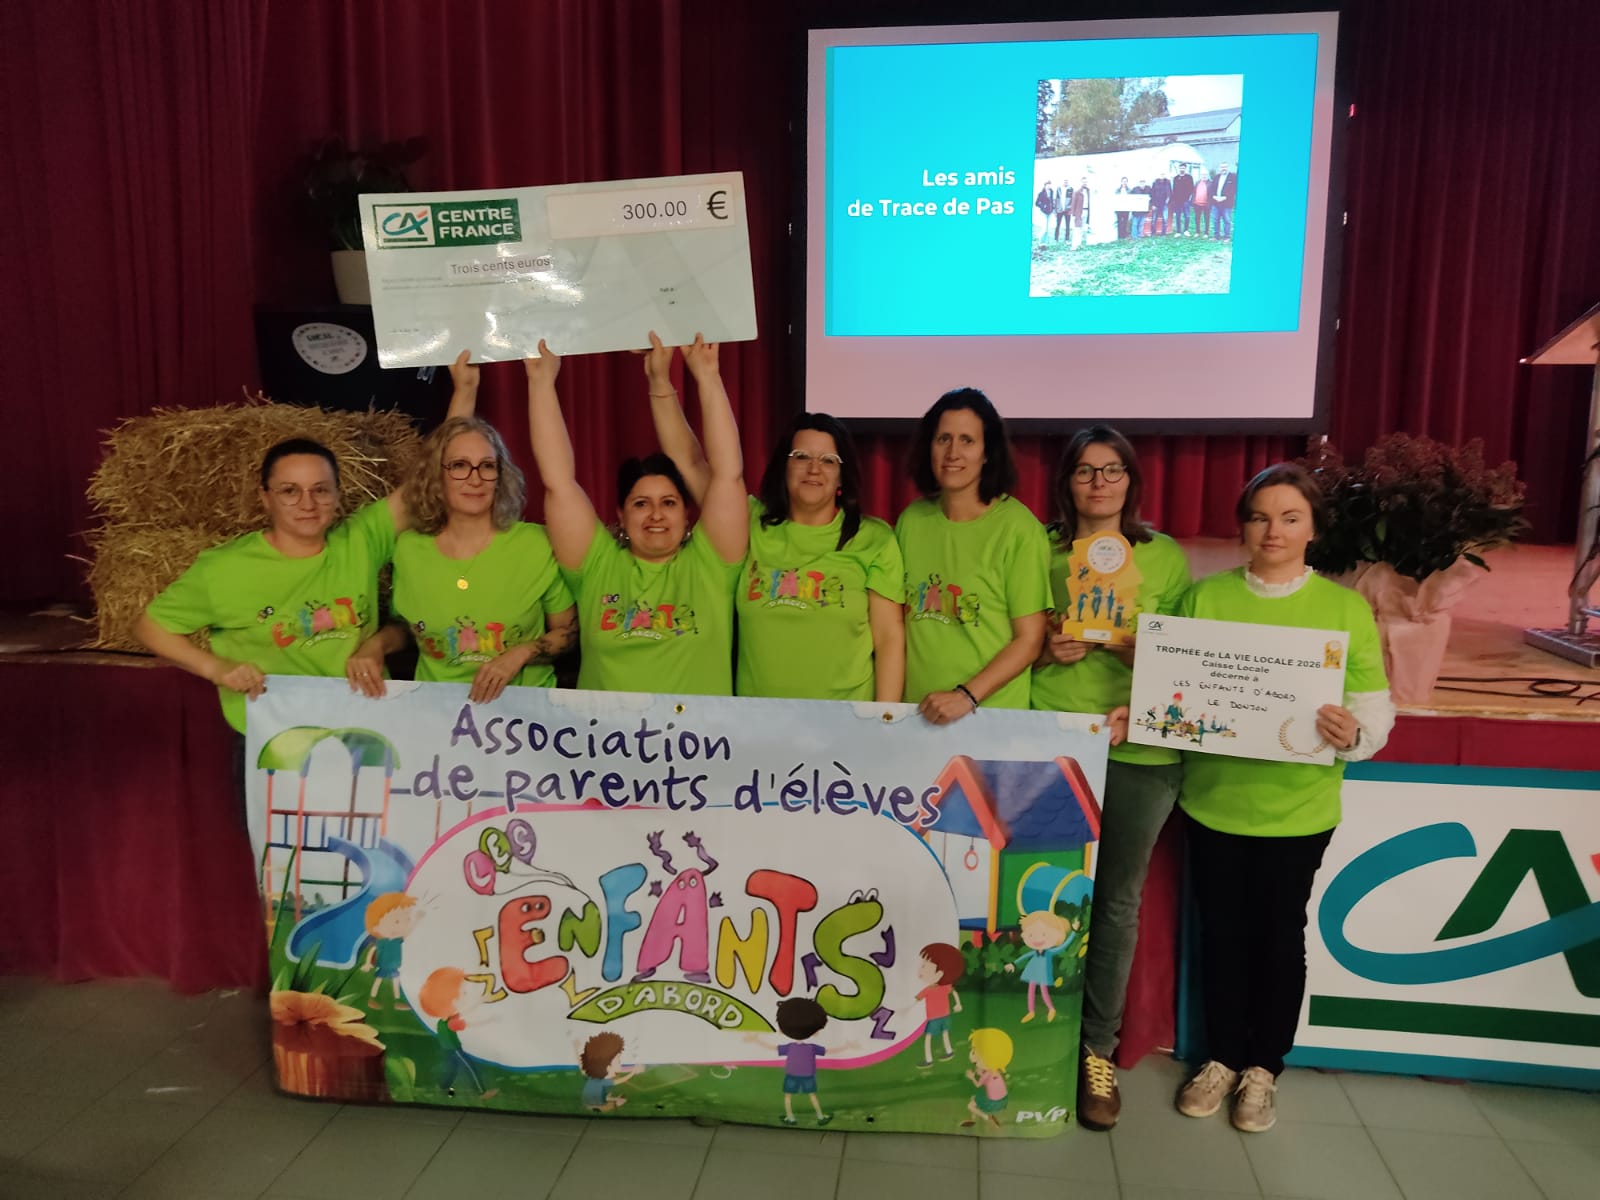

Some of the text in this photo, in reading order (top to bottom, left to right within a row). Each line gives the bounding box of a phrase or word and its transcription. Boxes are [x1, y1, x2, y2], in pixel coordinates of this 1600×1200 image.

[922, 165, 1016, 187] Les amis
[437, 207, 514, 223] CENTRE
[623, 190, 729, 220] 300.00 €
[847, 197, 1015, 217] de Trace de Pas
[439, 223, 515, 239] FRANCE
[450, 258, 550, 274] Trois cents euros
[1156, 644, 1321, 669] TROPHÉE de LA VIE LOCALE 2026
[1201, 659, 1270, 674] Caisse Locale
[1173, 679, 1191, 688] LES
[1210, 671, 1250, 682] décerné
[1207, 698, 1220, 707] LE
[450, 702, 732, 764] Association
[413, 754, 943, 827] de parents d'élèves
[466, 821, 535, 884] LES
[497, 862, 885, 1021] ENFANTS
[597, 982, 745, 1030] D'ABORD
